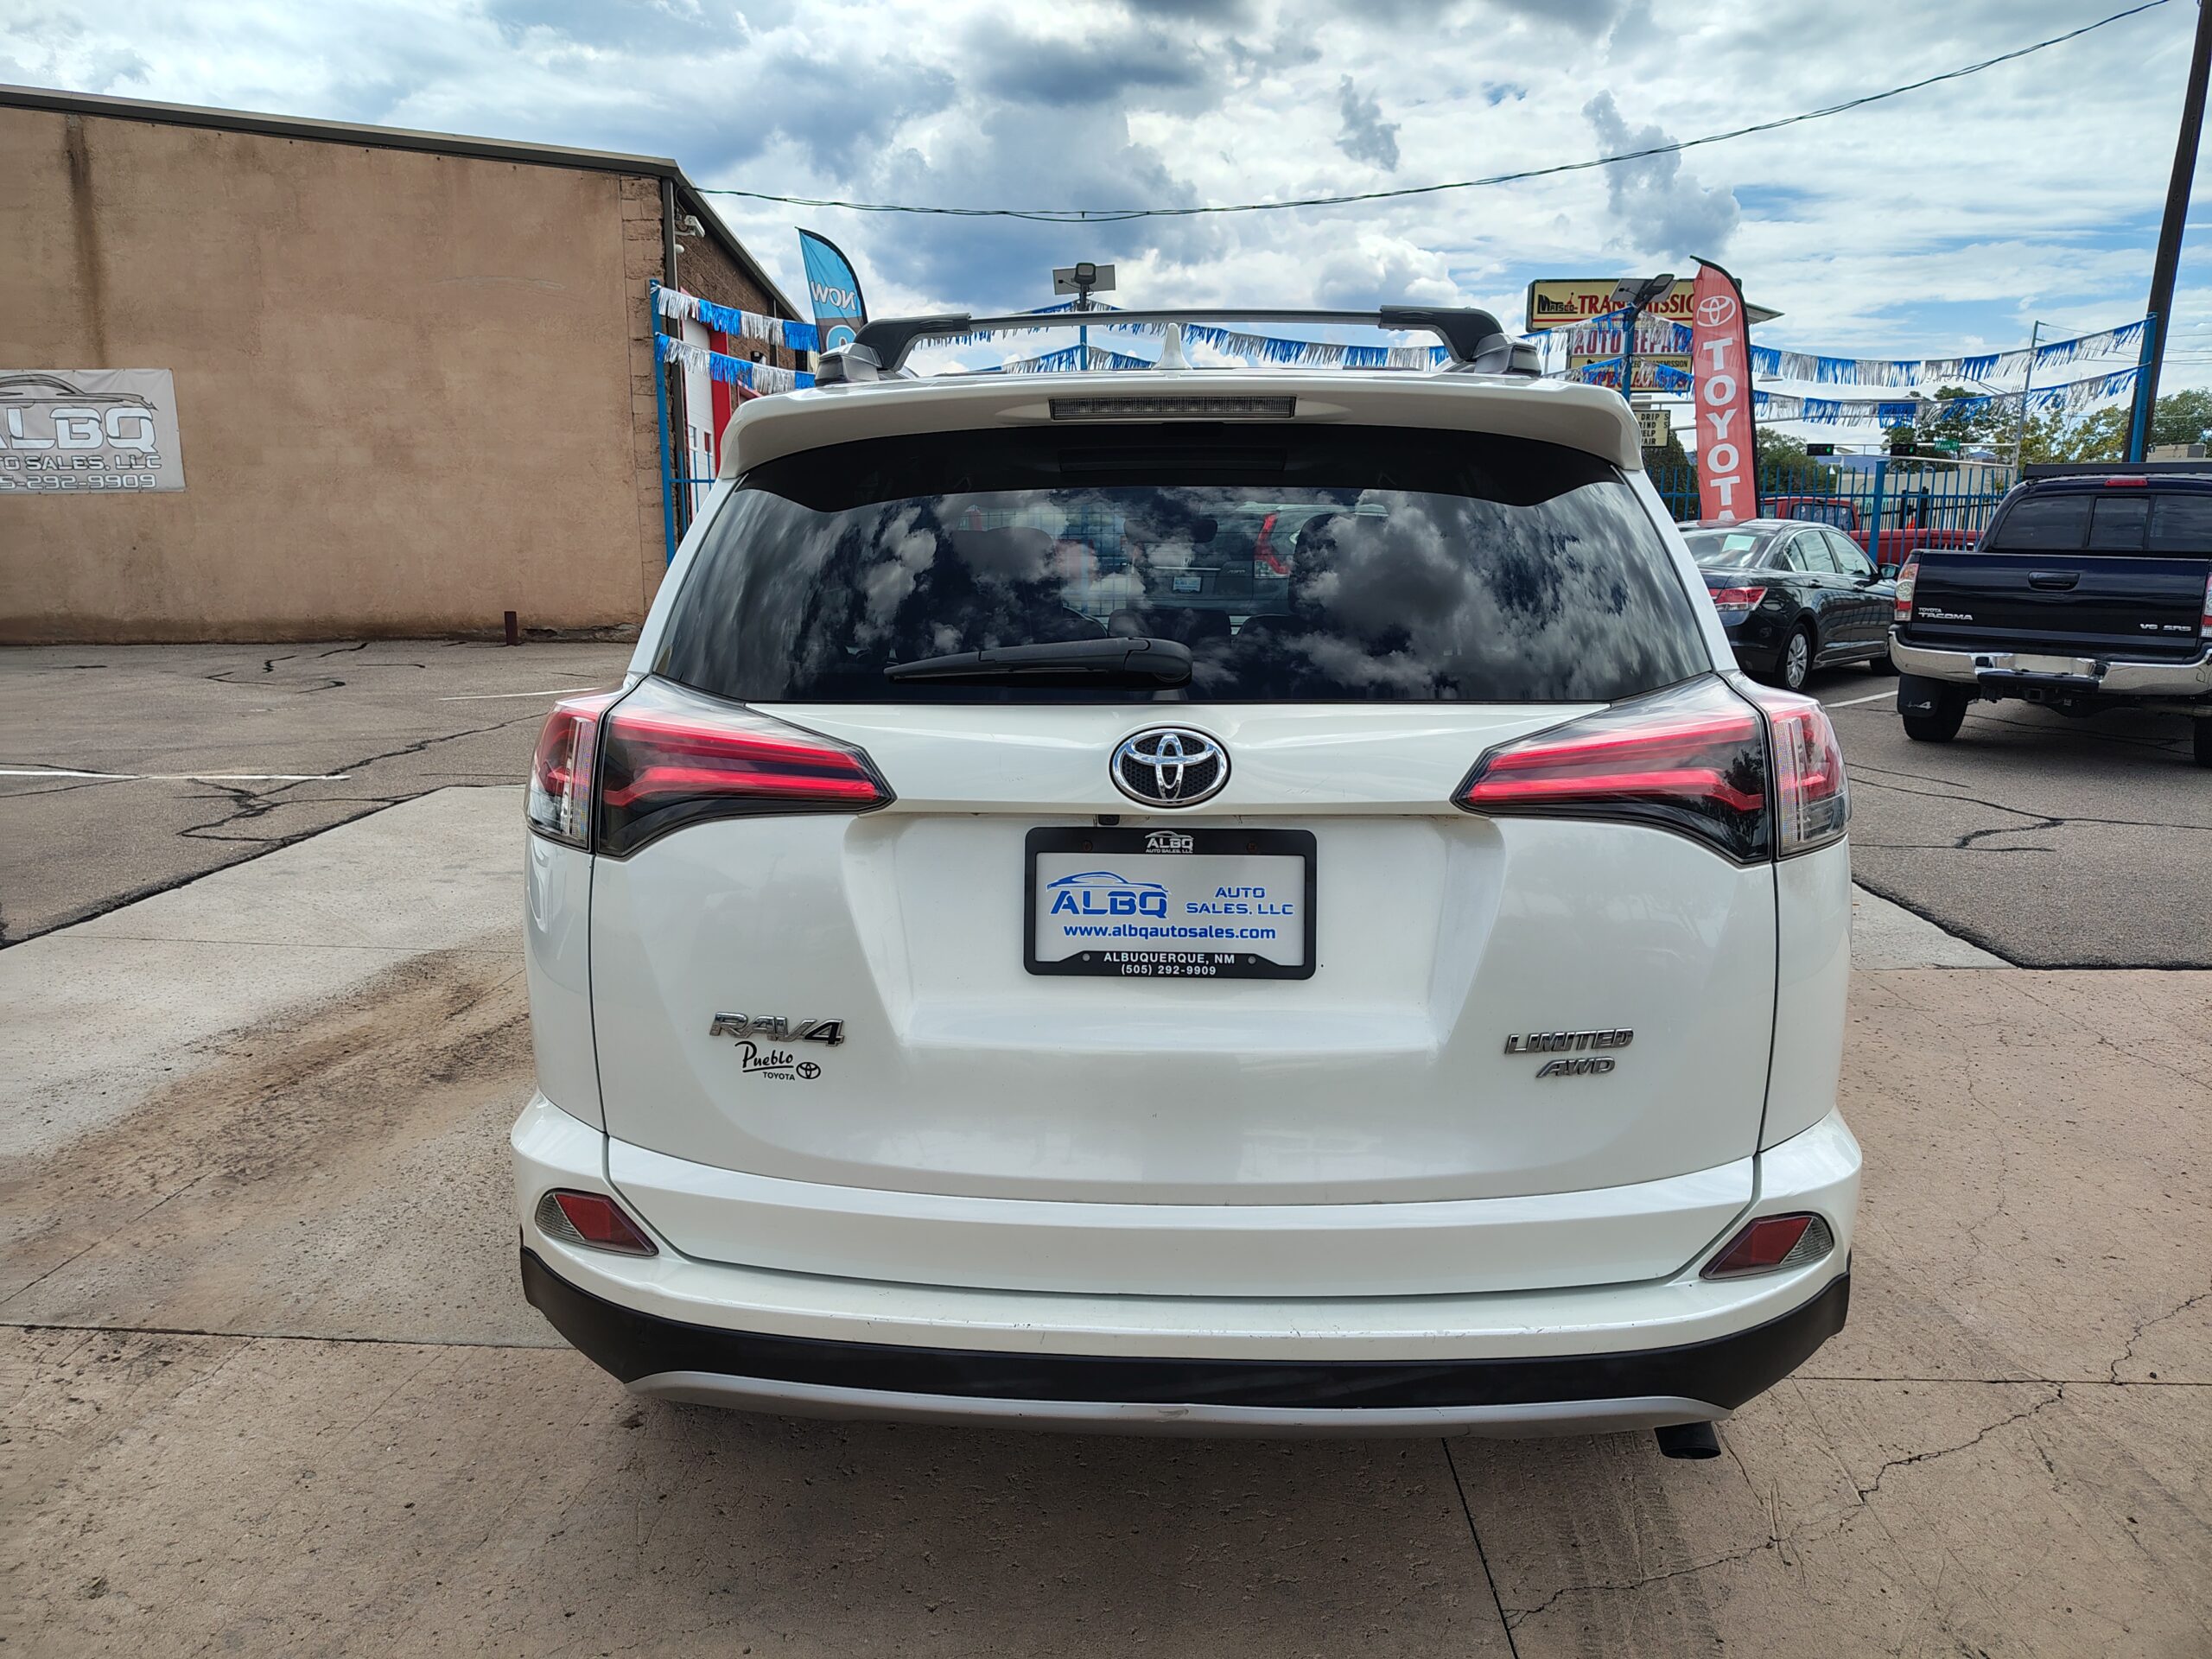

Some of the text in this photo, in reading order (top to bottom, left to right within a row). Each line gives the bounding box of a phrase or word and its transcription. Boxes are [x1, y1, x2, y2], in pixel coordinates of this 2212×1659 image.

[1573, 329, 1622, 354] AUTO
[0, 407, 158, 454] LBQ
[114, 454, 162, 470] LLC
[1918, 612, 1973, 620] TACOMA
[1147, 837, 1193, 851] ALBQ
[1050, 887, 1266, 919] ALBQ AUTO
[1257, 904, 1294, 916] LLC
[1063, 924, 1276, 940] www.albqautosales.com
[1103, 952, 1235, 964] ALBUQUERQUE, NM
[1121, 965, 1217, 976] (505) 292-9909
[709, 1012, 844, 1046] RAV4
[1504, 1027, 1634, 1054] LIMITED
[734, 1041, 793, 1069] Pueblo
[1535, 1056, 1616, 1077] AWD
[763, 1071, 795, 1081] TOYOTA
